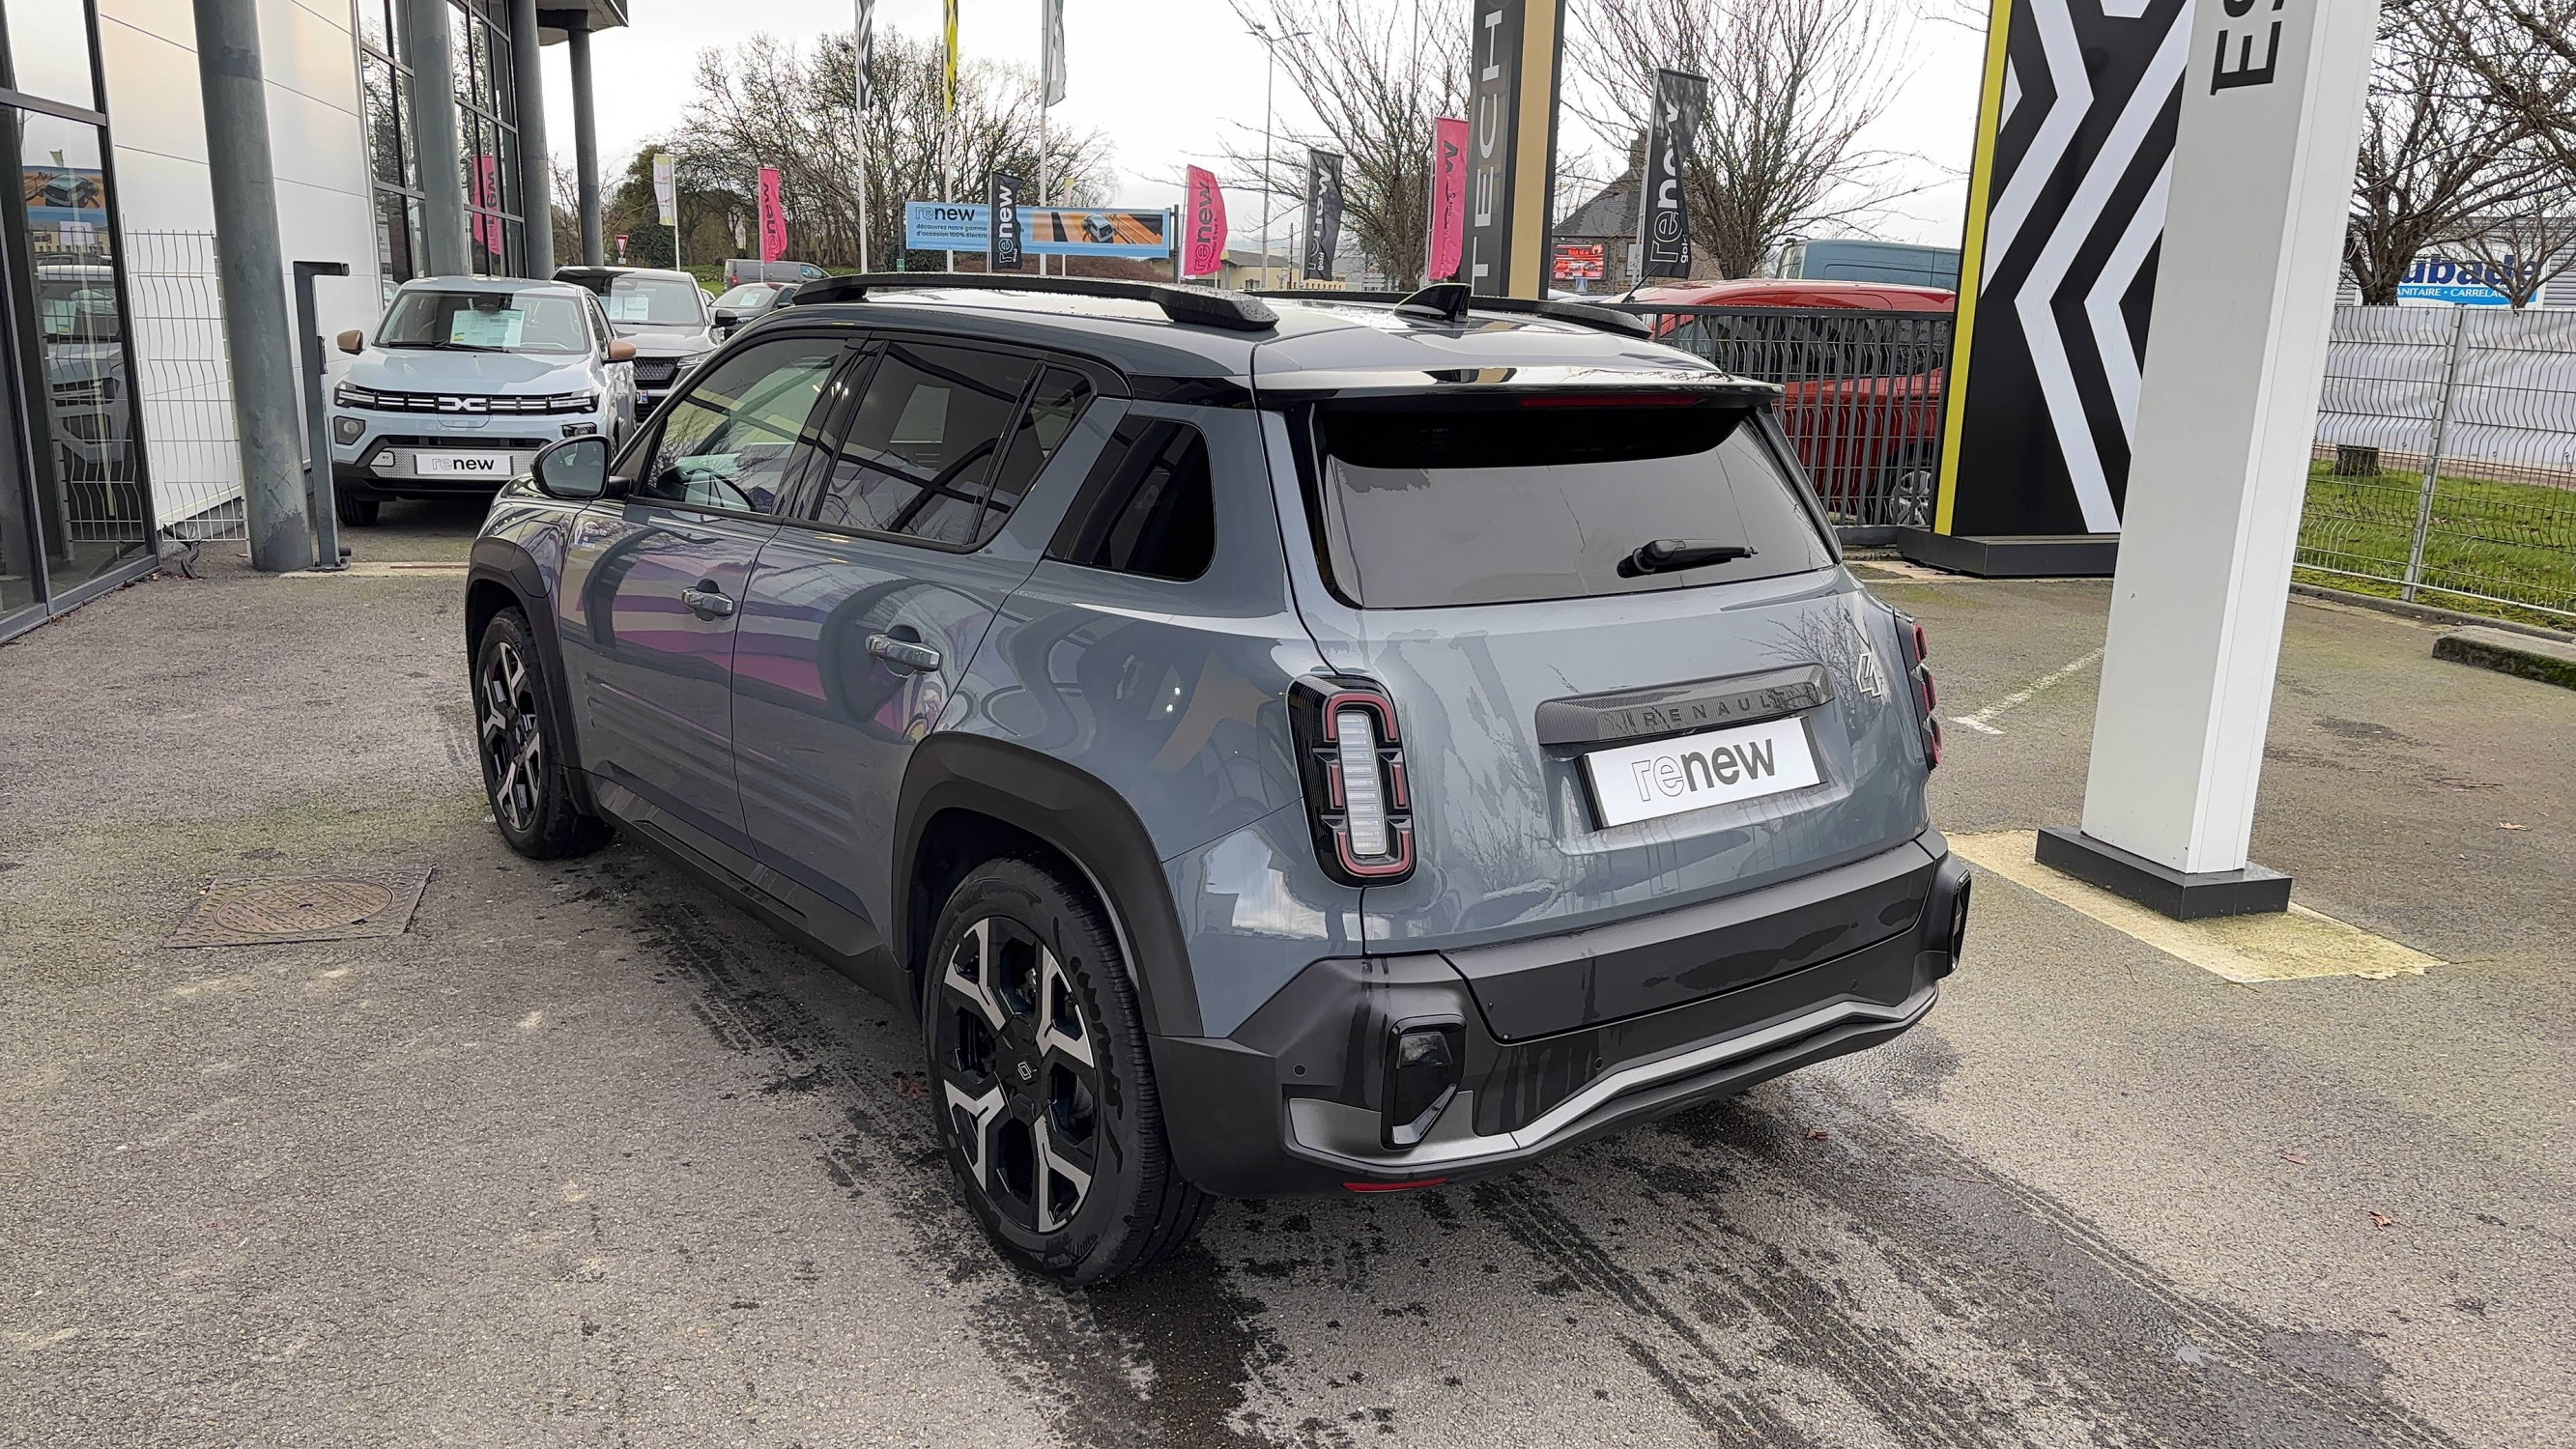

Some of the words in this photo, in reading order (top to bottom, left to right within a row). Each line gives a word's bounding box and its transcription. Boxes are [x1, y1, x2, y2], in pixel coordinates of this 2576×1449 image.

[1471, 9, 1503, 297] TECH
[915, 206, 975, 222] renew
[998, 185, 1014, 264] renew
[1194, 181, 1214, 271] renew
[916, 230, 949, 239] d'occasion
[2400, 253, 2539, 285] ubade
[2450, 288, 2506, 298] CARRELA
[432, 458, 495, 470] renew
[1630, 737, 1776, 803] renew
